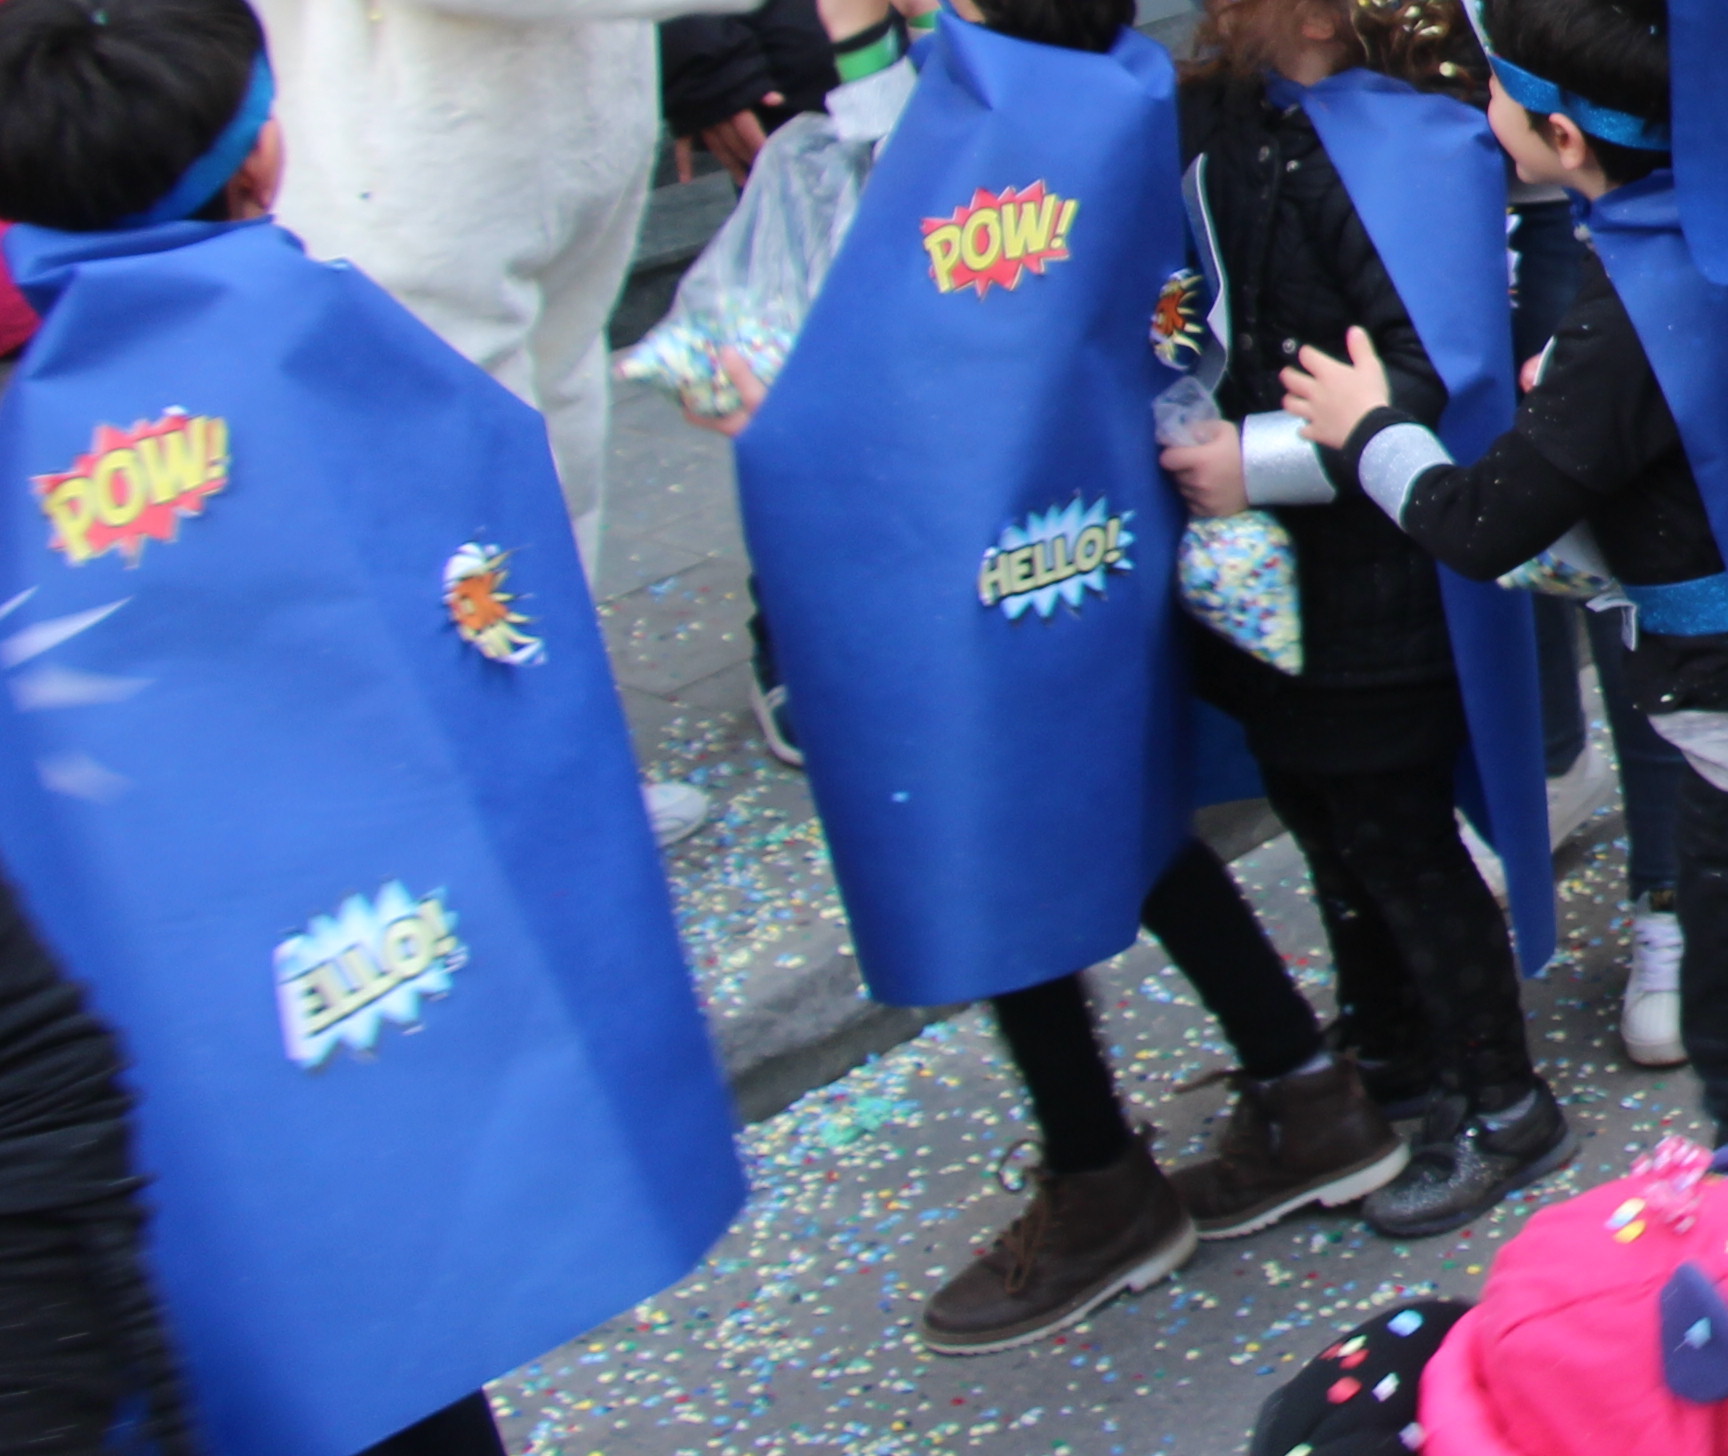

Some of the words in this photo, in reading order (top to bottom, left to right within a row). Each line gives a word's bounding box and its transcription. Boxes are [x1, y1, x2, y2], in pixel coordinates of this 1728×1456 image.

[923, 193, 1078, 294] POW!
[43, 414, 229, 562] POW!
[978, 516, 1122, 606] HELLO!
